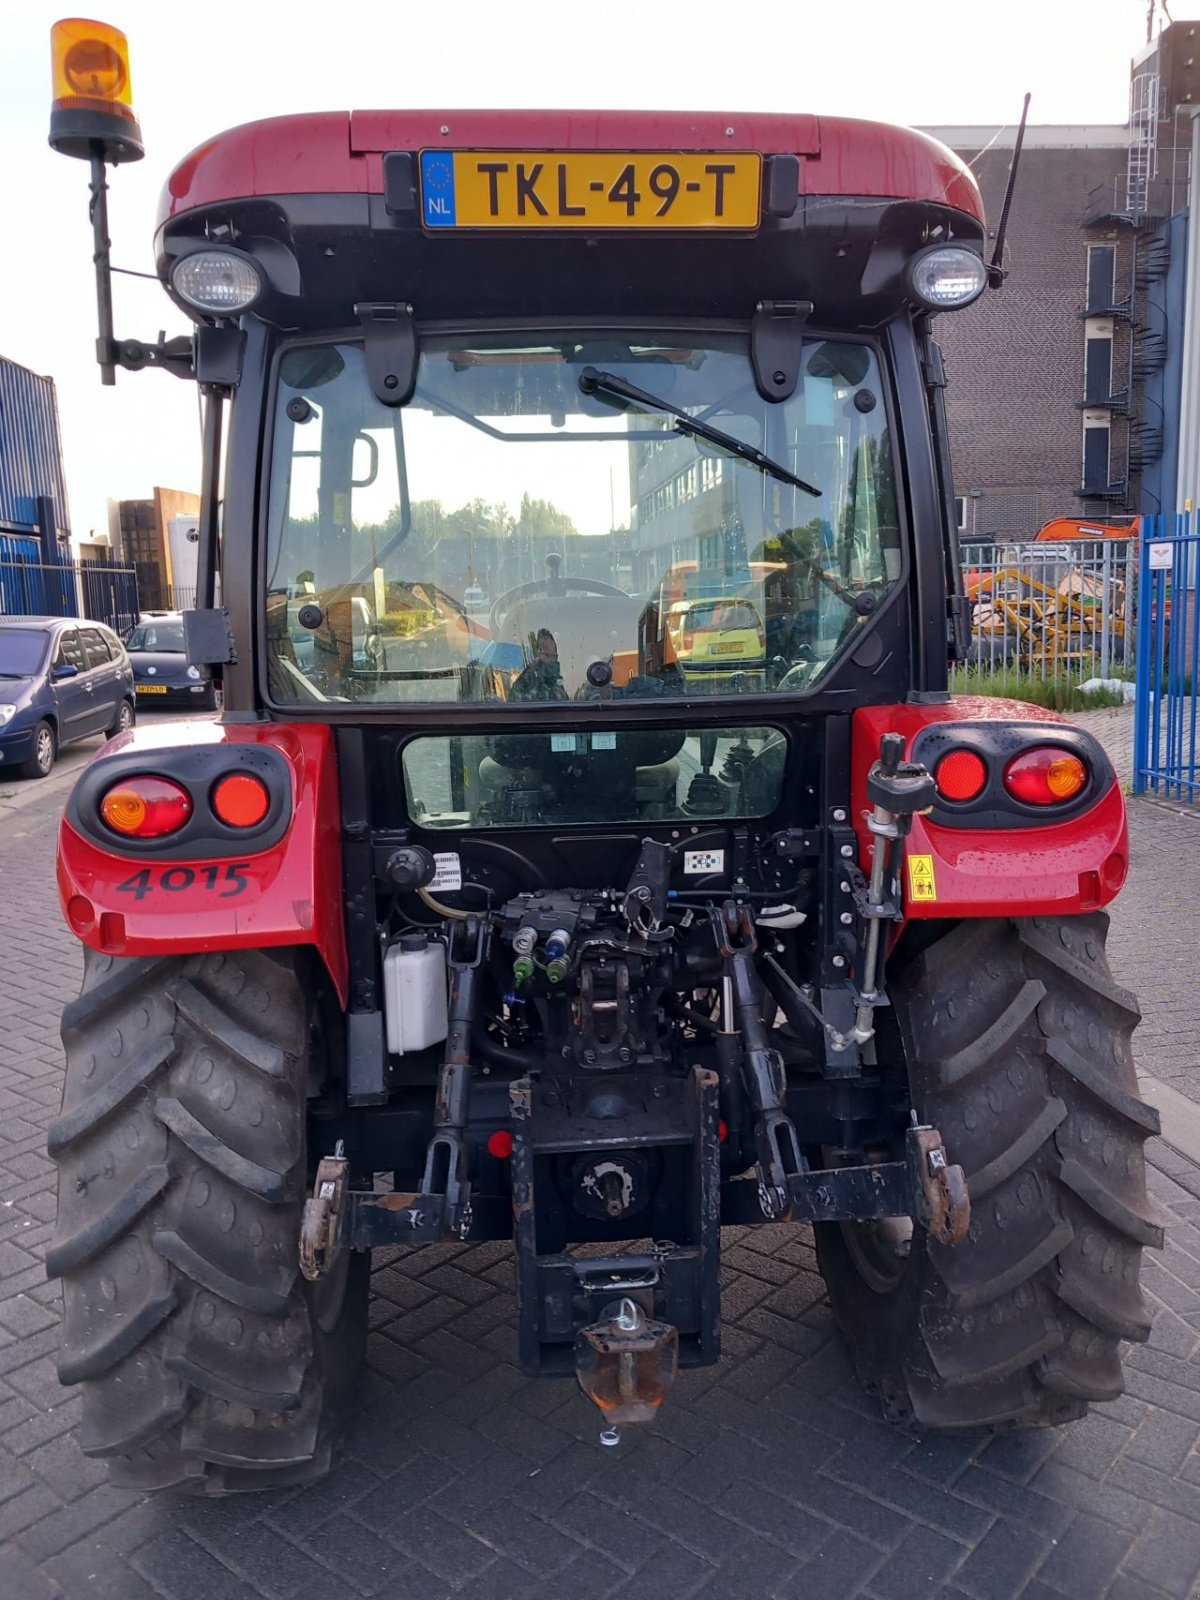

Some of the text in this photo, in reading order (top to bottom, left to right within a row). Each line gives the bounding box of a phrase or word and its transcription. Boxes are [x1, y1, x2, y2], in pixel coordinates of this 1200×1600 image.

[428, 197, 451, 214] NL
[476, 163, 737, 217] TKL-49-T
[115, 862, 251, 901] 4015
